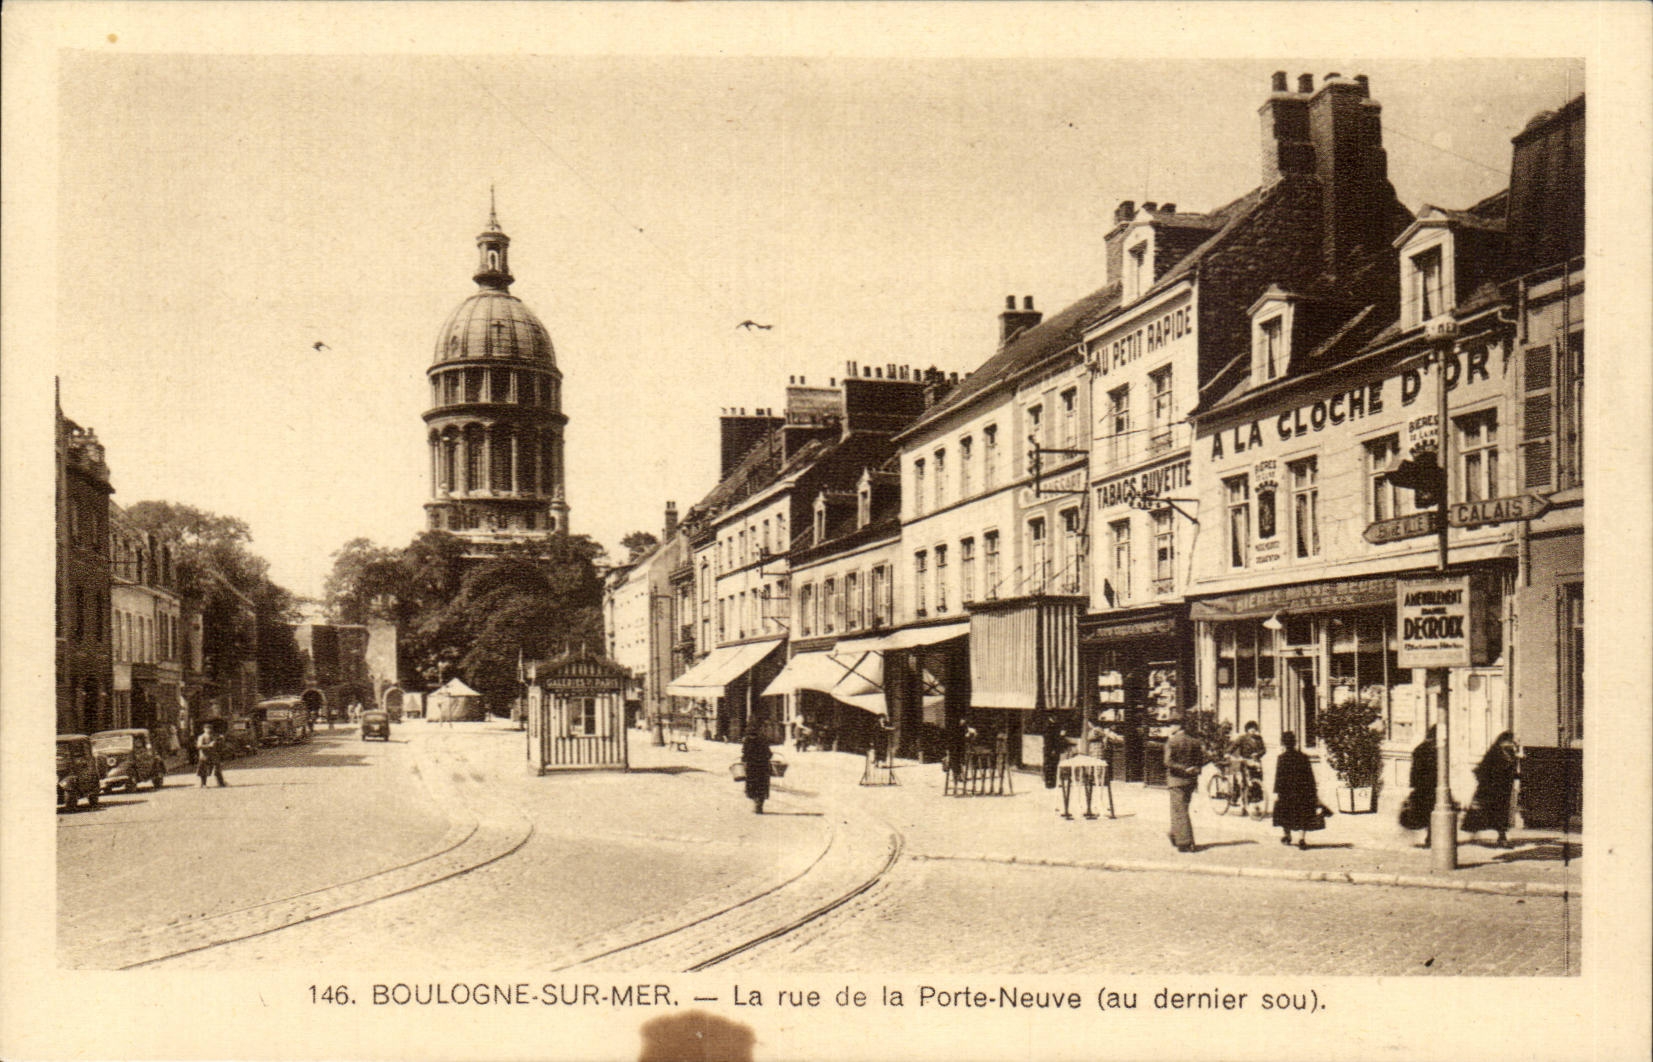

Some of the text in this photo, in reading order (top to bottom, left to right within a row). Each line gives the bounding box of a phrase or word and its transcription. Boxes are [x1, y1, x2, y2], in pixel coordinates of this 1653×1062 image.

[1113, 329, 1143, 369] PETIT
[1147, 305, 1192, 353] RAPIDE
[1211, 348, 1489, 461] A LA CLOCHE D'OR
[1097, 459, 1192, 510] TABACS BUVETTE
[1458, 501, 1523, 523] CALAIS
[1403, 615, 1464, 640] DECROIX
